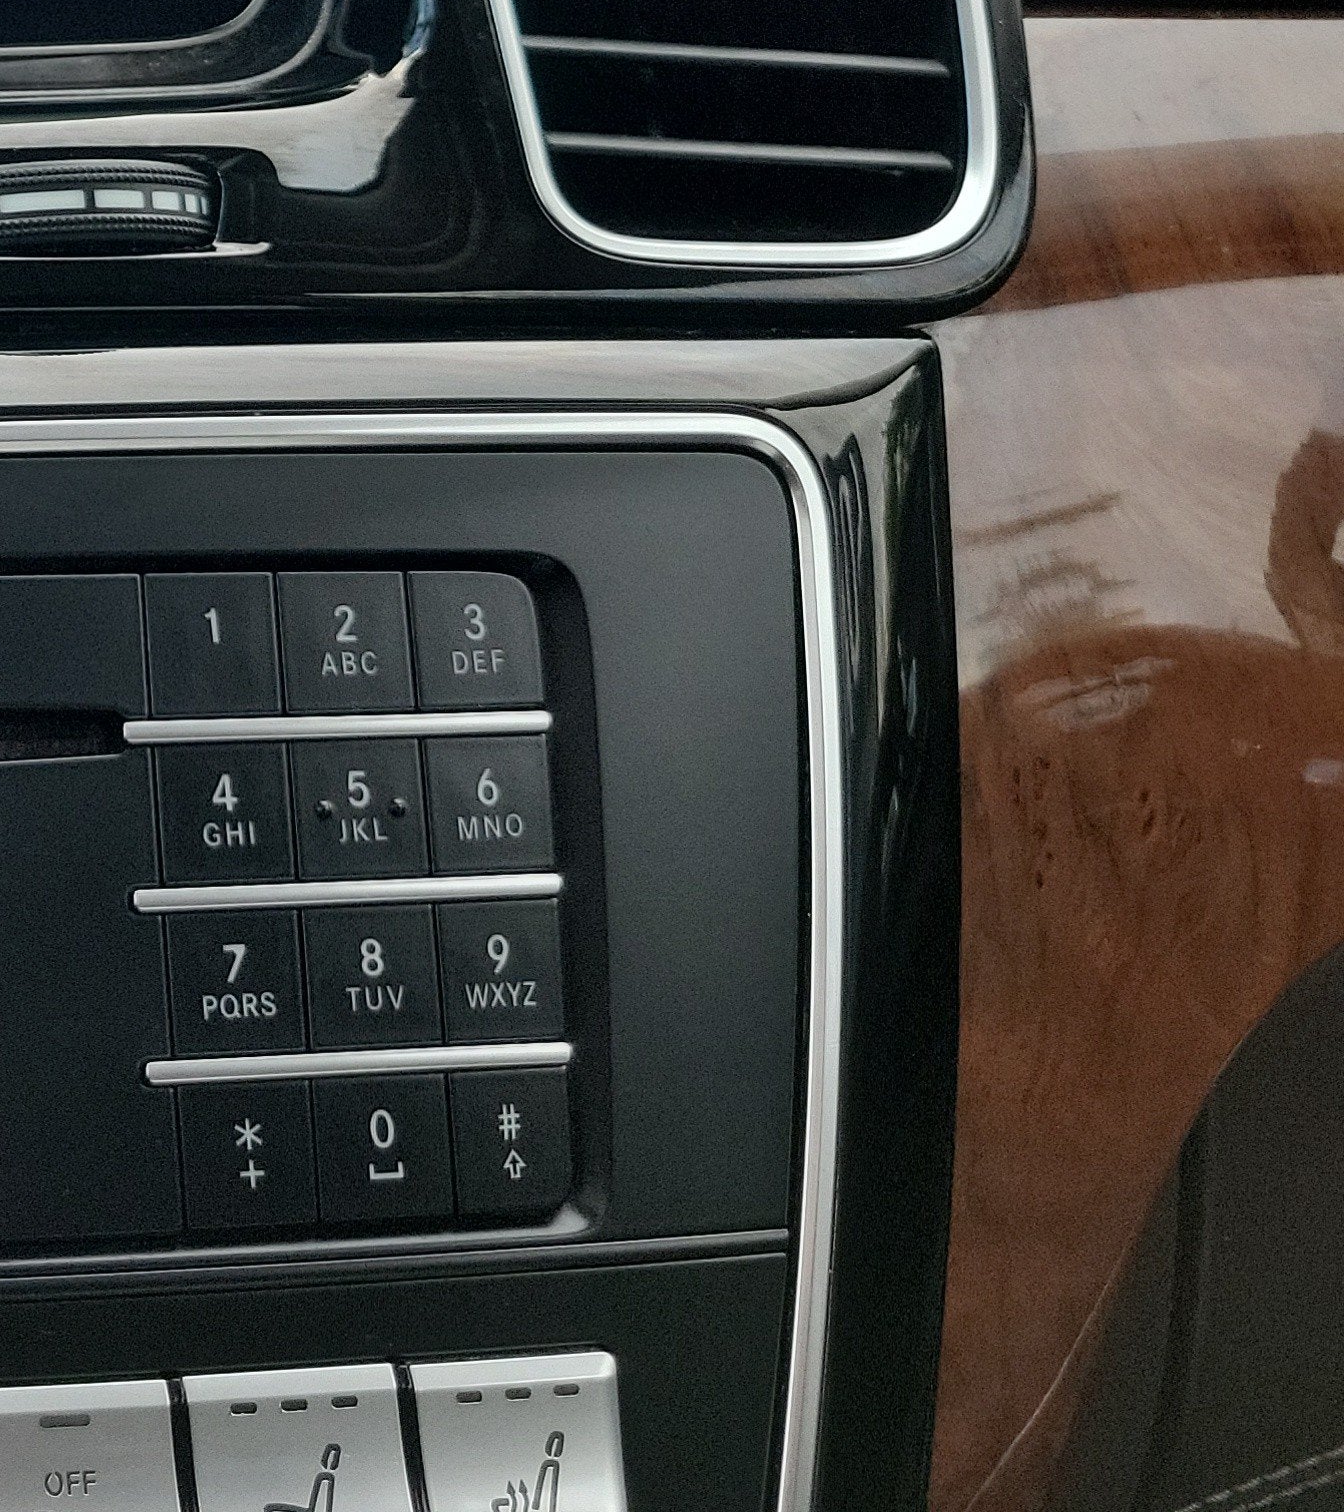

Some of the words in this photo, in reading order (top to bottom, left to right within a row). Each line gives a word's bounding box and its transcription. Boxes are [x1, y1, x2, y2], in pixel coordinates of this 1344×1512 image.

[203, 607, 223, 645] 1
[333, 604, 358, 642] 2
[462, 603, 487, 640] 3
[321, 651, 379, 677] ABC
[451, 649, 507, 675] DEF
[212, 773, 238, 812] 4
[346, 770, 369, 808] 5
[476, 768, 499, 806] 6
[202, 821, 256, 847] GHI
[338, 818, 388, 842] JKL
[457, 814, 524, 839] MNO
[221, 943, 247, 984] 7
[358, 938, 385, 977] 8
[485, 933, 510, 974] 9
[201, 991, 278, 1021] PQRS
[345, 985, 405, 1013] TUV
[464, 981, 538, 1008] WXYZ
[368, 1108, 395, 1150] 0
[43, 1469, 97, 1497] OFF
